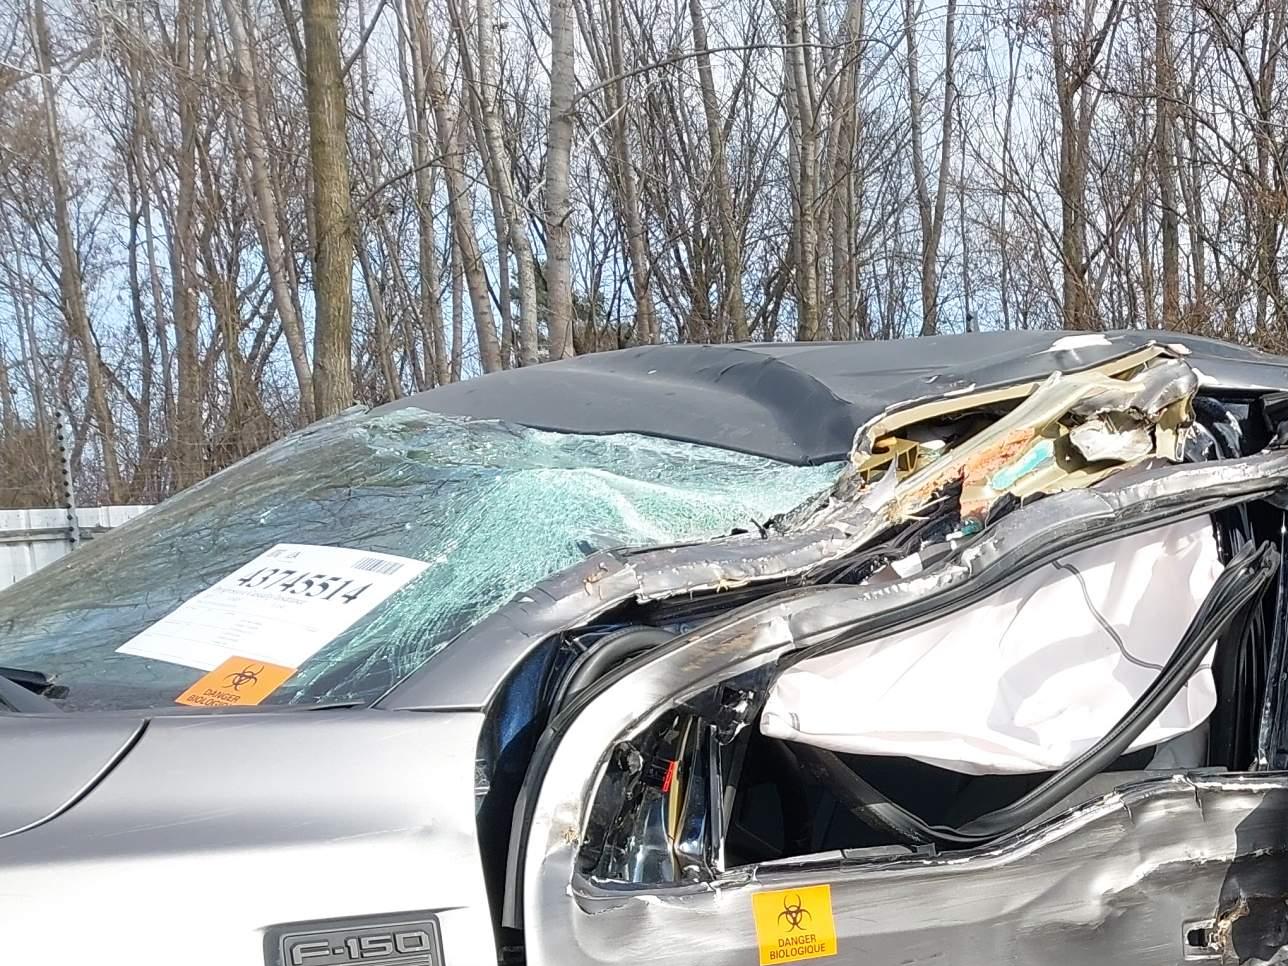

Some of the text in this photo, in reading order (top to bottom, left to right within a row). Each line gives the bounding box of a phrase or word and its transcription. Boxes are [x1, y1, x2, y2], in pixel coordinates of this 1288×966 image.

[237, 567, 373, 604] 43745514
[203, 688, 240, 703] DANGER
[291, 930, 431, 966] F-150
[778, 934, 816, 948] DANGER
[769, 942, 826, 960] BIOLOGIQUE
